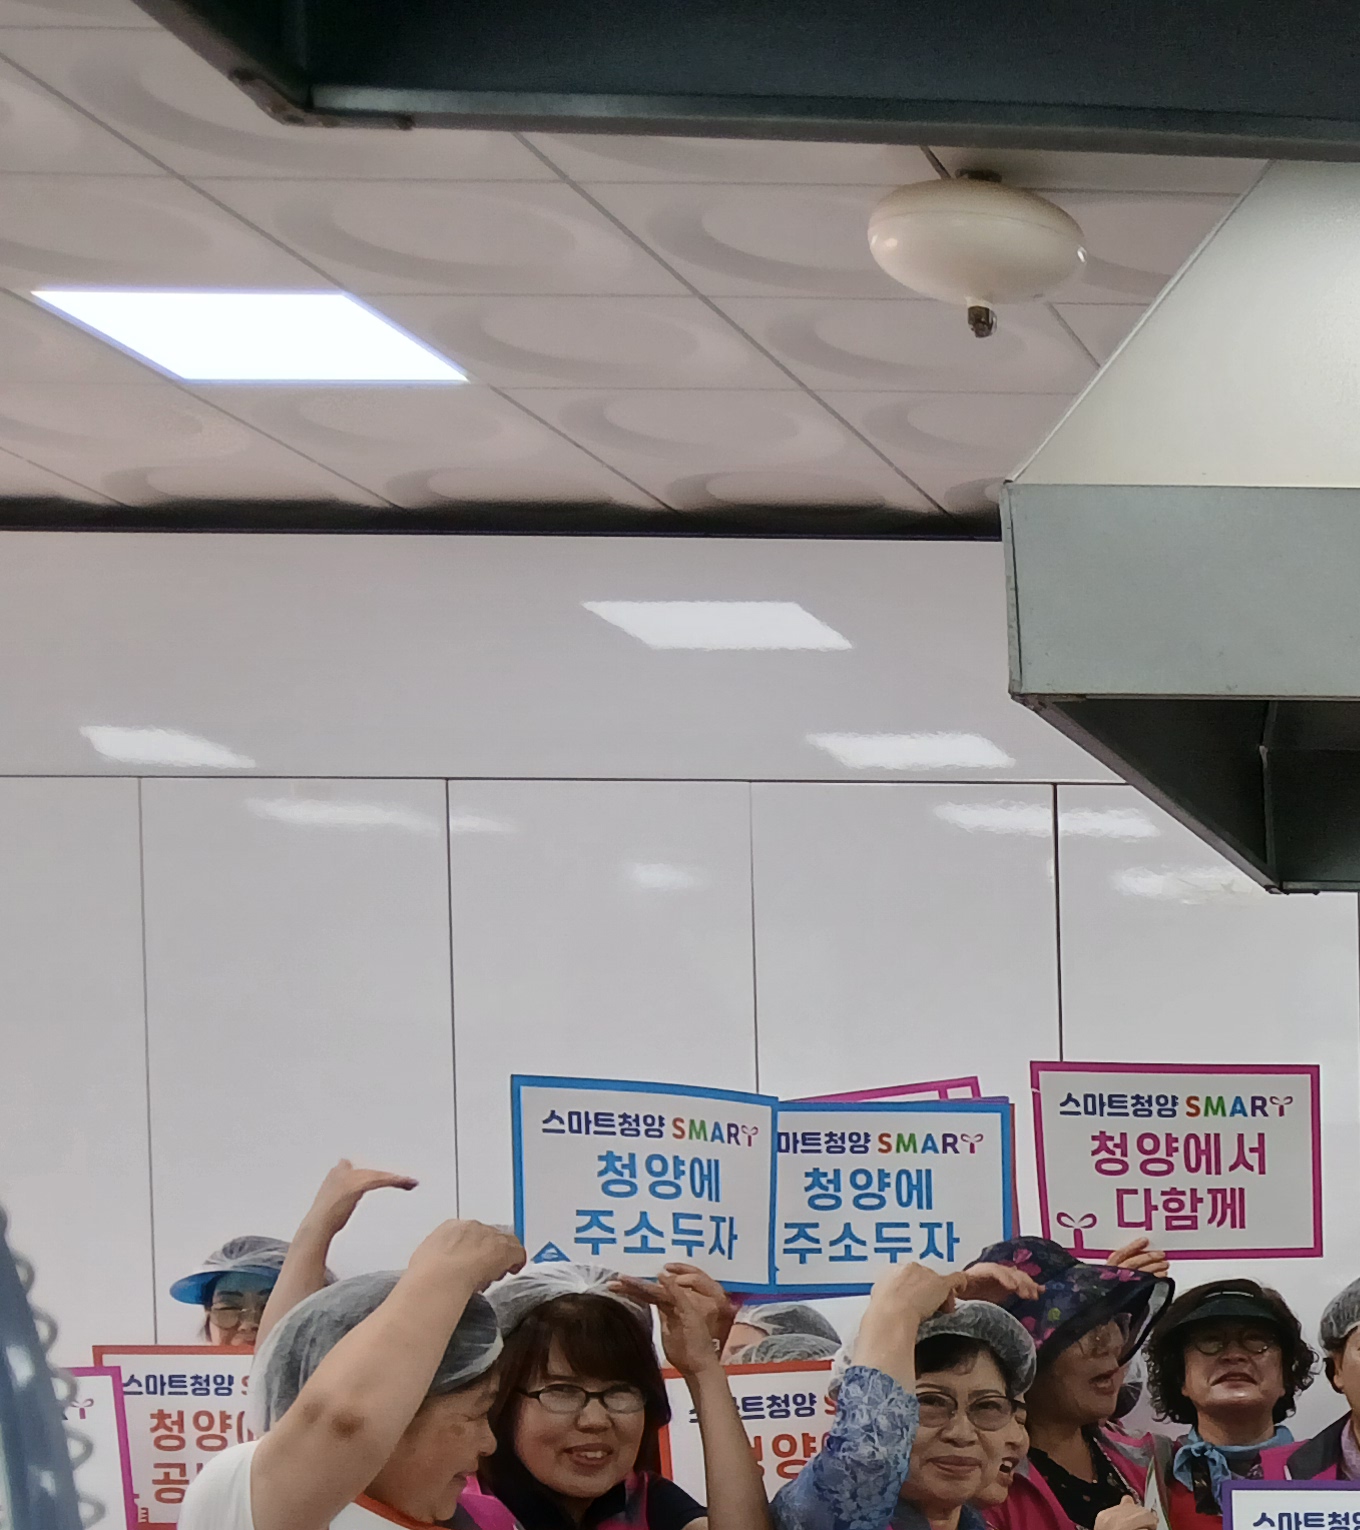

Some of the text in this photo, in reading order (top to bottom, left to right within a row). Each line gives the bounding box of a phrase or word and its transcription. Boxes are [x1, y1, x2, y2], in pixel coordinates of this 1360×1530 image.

[541, 1108, 666, 1141] 스마트청양
[1058, 1092, 1179, 1119] 스마트청양
[777, 1131, 871, 1154] 마트청양
[1089, 1131, 1267, 1178] 청양에서
[596, 1151, 723, 1203] 청양에
[803, 1167, 935, 1212] 청양에
[1115, 1188, 1247, 1233] 다함께
[573, 1209, 739, 1261] 주소두자
[782, 1220, 960, 1265] 주소두자
[123, 1373, 235, 1397] 스마트청양
